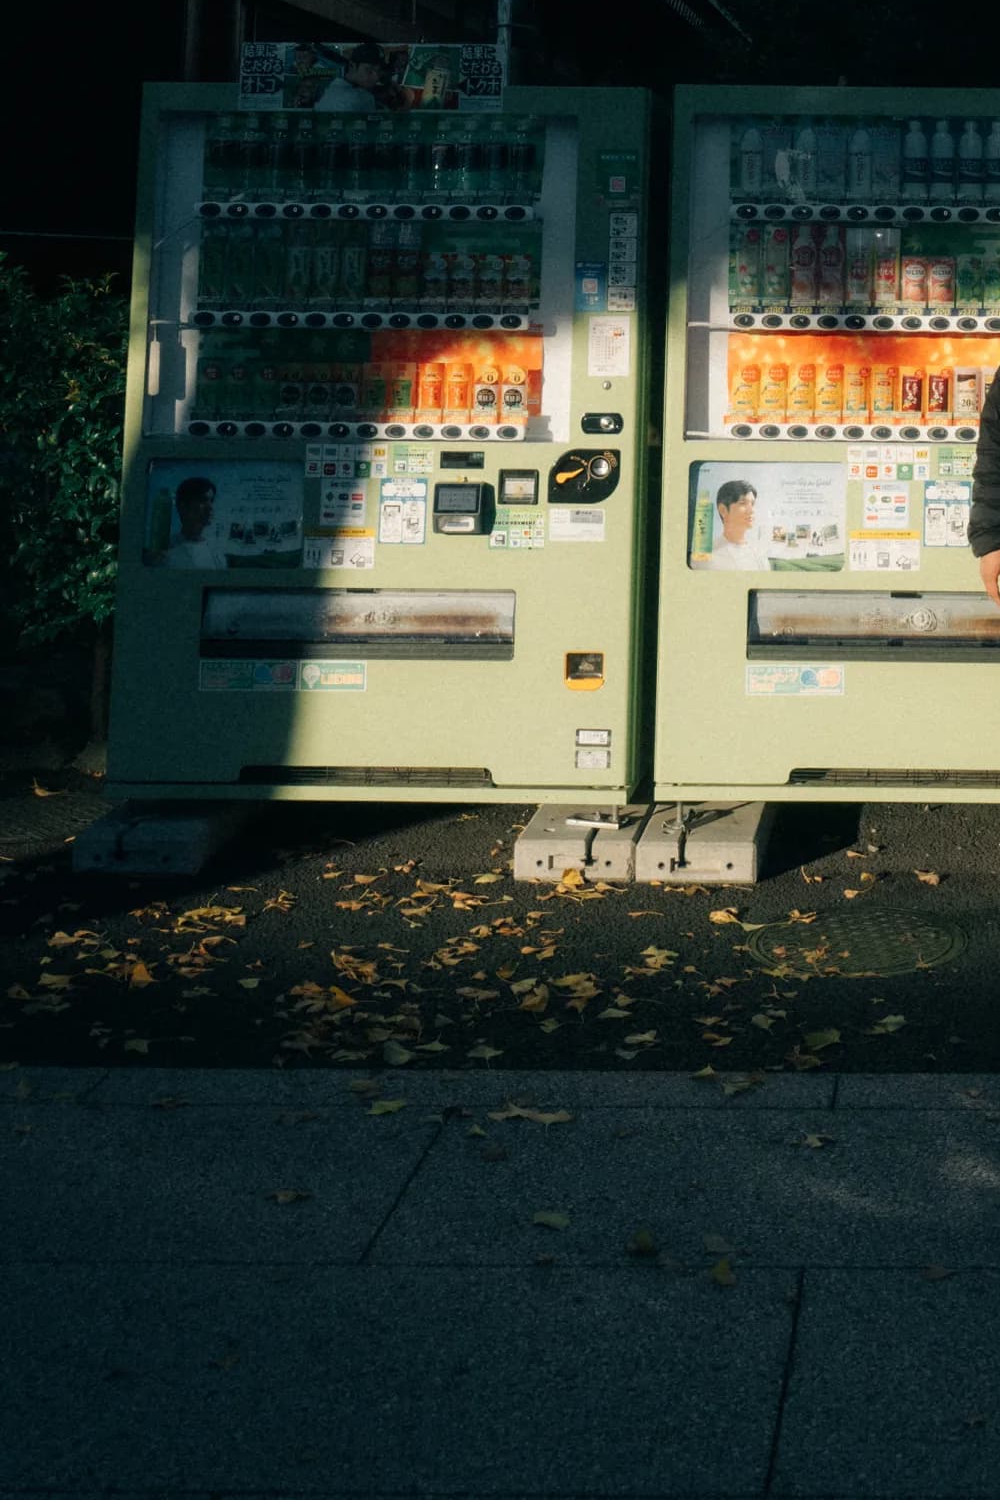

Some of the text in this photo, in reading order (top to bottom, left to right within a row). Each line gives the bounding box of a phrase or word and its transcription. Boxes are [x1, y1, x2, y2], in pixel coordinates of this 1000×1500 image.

[242, 76, 277, 93] オトコ
[466, 77, 500, 94] トクホ
